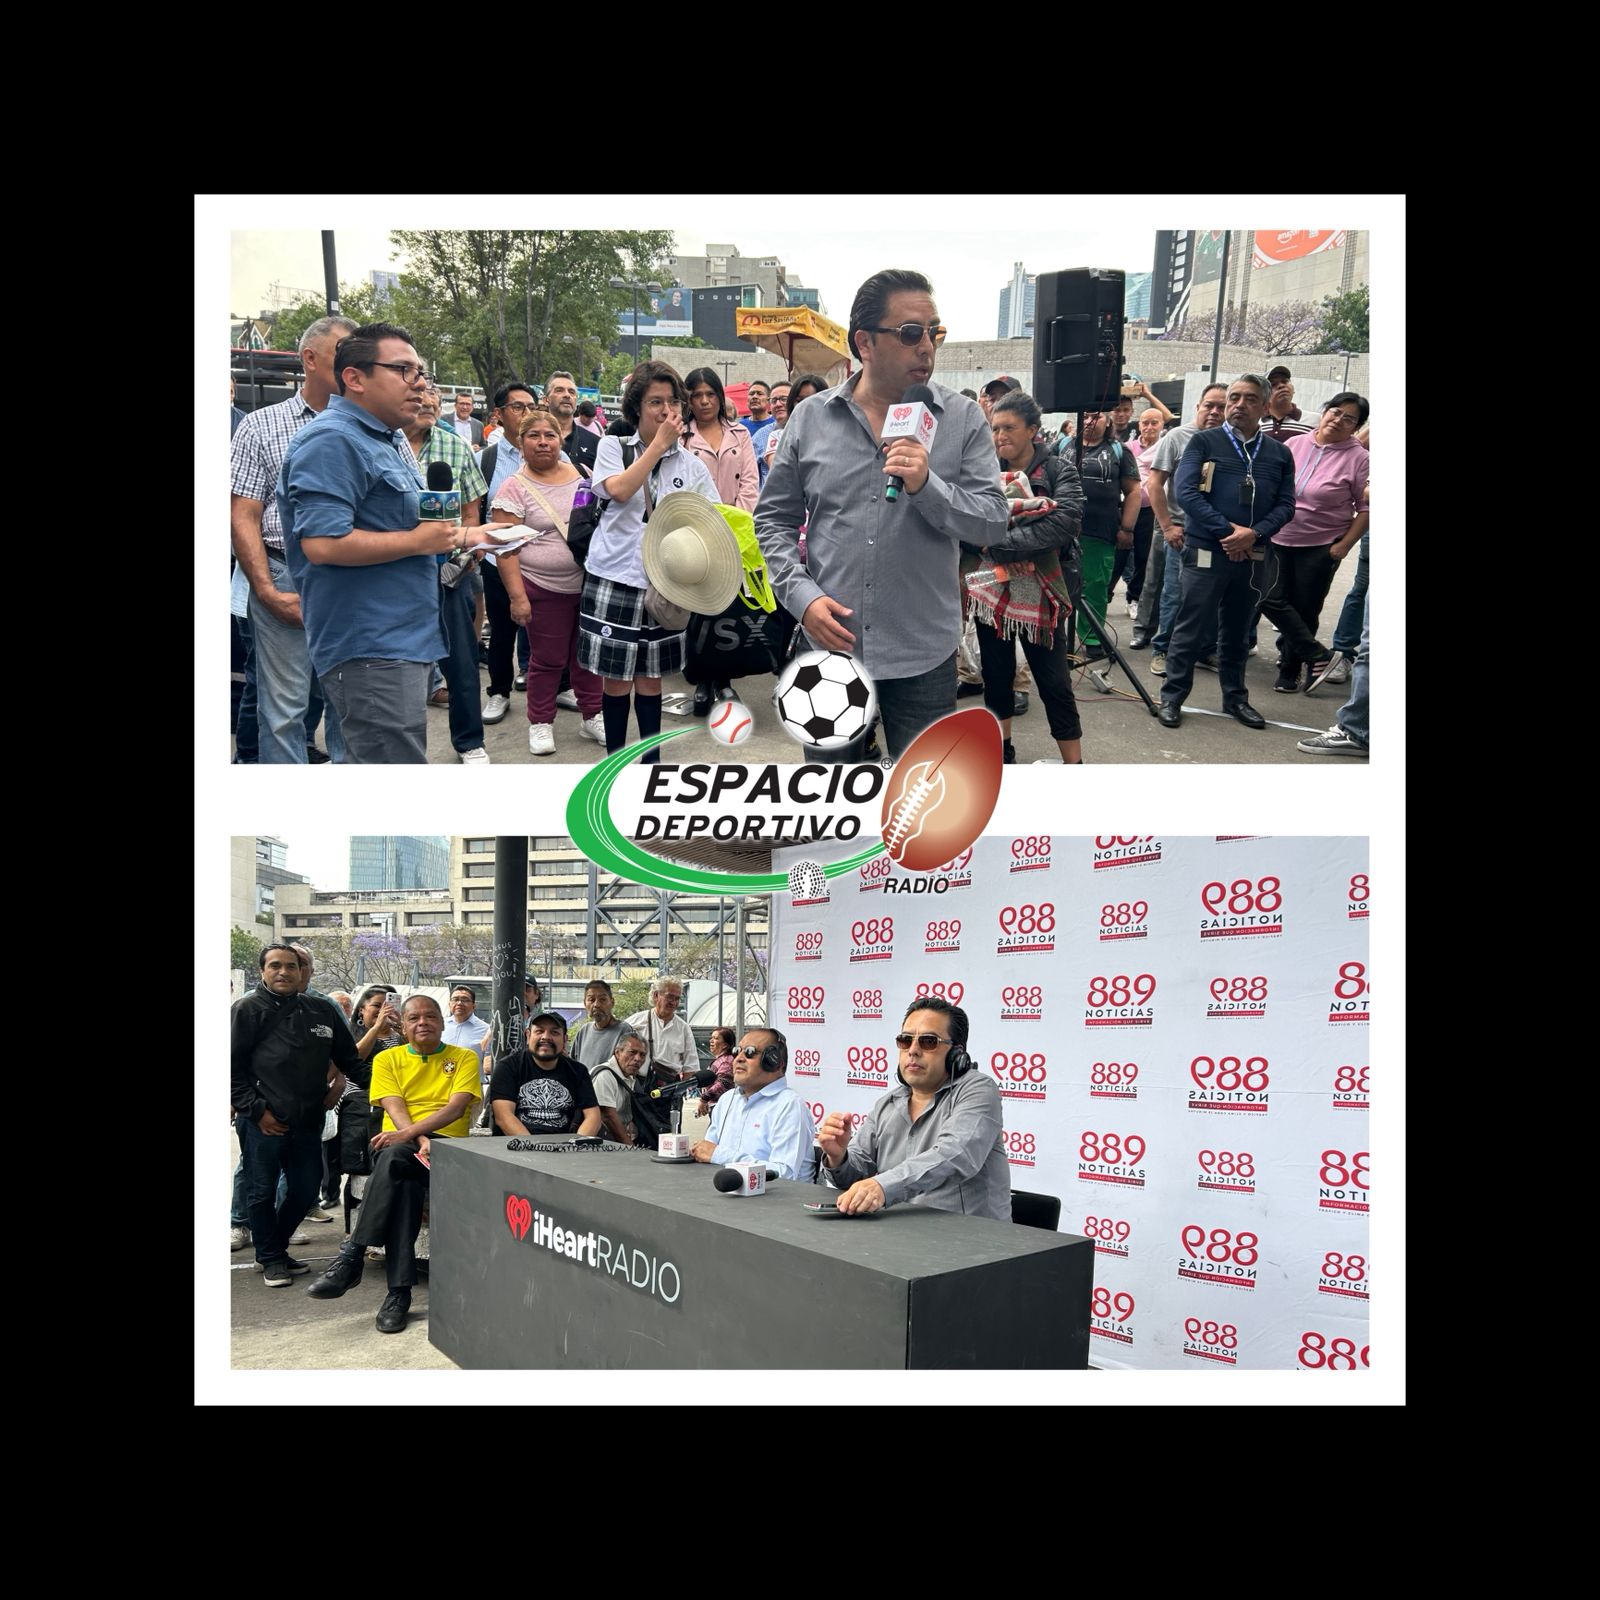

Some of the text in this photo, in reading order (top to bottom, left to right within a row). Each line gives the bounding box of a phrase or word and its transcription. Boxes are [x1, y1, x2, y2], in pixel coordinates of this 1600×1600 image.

[1094, 842, 1162, 860] NOTICIAS
[1101, 901, 1148, 927] 88.9
[926, 919, 962, 941] 88.9
[1100, 925, 1148, 934] NOTICIAS
[796, 932, 823, 952] 88.9
[925, 940, 961, 948] NOTICIAS
[788, 986, 825, 1010] 88.9
[1087, 974, 1157, 1008] 88.9
[788, 1010, 825, 1018] NOTICIAS
[1085, 1007, 1154, 1018] NOTICIAS
[795, 1050, 821, 1067] 88.9
[1091, 1062, 1139, 1086] 88.9
[1090, 1085, 1138, 1093] NOTICIAS
[1079, 1131, 1147, 1167] 88.9
[1078, 1162, 1146, 1178] NOTICIAS
[1084, 1215, 1131, 1243] 88.9
